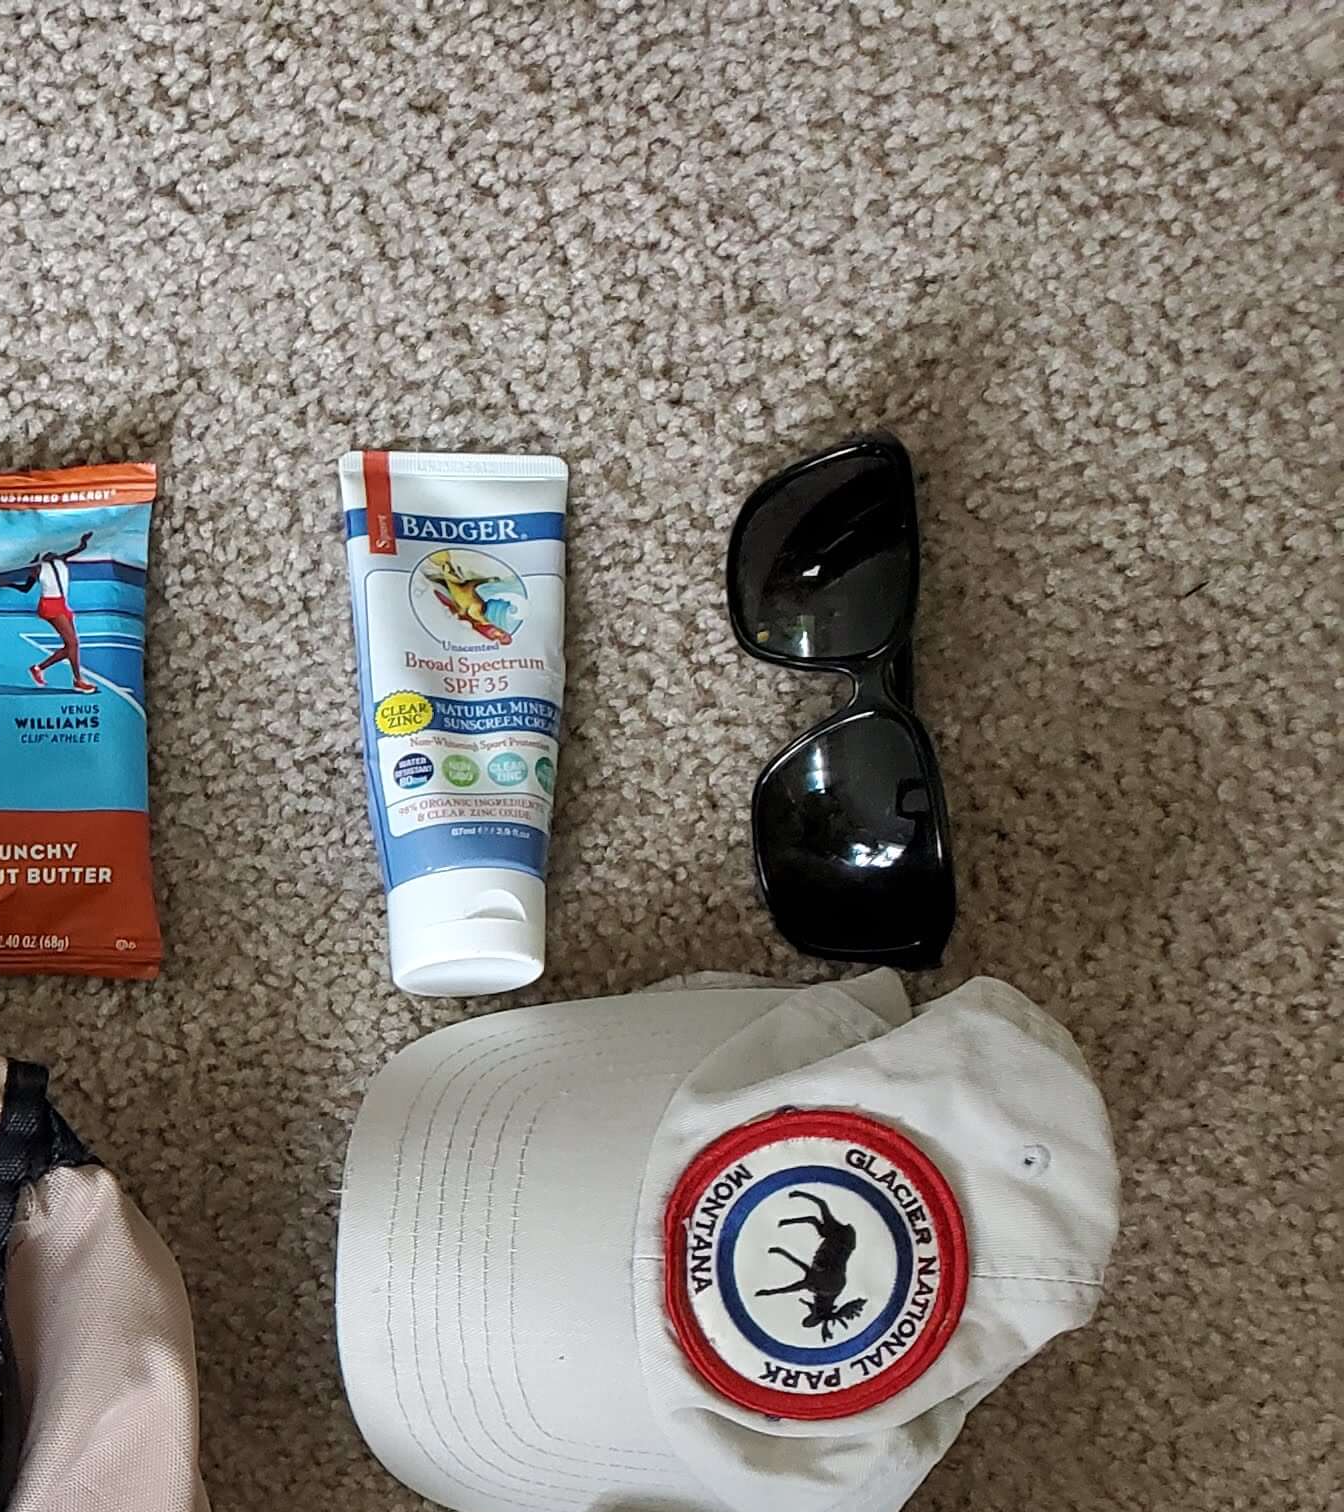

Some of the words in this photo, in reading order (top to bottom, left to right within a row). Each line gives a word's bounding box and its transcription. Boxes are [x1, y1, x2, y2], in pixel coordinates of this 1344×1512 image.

[400, 516, 519, 541] BADGER
[405, 652, 454, 672] Broad
[458, 657, 545, 677] Spectrum
[443, 677, 481, 694] SPF
[484, 676, 510, 693] 35
[60, 705, 100, 714] VENUS
[380, 702, 428, 718] CLEAR
[436, 701, 507, 717] NATURAL
[15, 717, 100, 729] WILLIAMS
[387, 714, 424, 729] ZINC
[444, 716, 523, 731] SUNSCREEN
[50, 733, 100, 744] ATHLETE
[470, 807, 498, 818] ZINC
[27, 867, 112, 884] BUTTER
[40, 935, 69, 952] (68g)
[845, 1149, 932, 1245] GLACIER
[690, 1163, 754, 1295] MONTANA
[850, 1256, 937, 1376] NATIONAL
[758, 1361, 841, 1390] PARK
